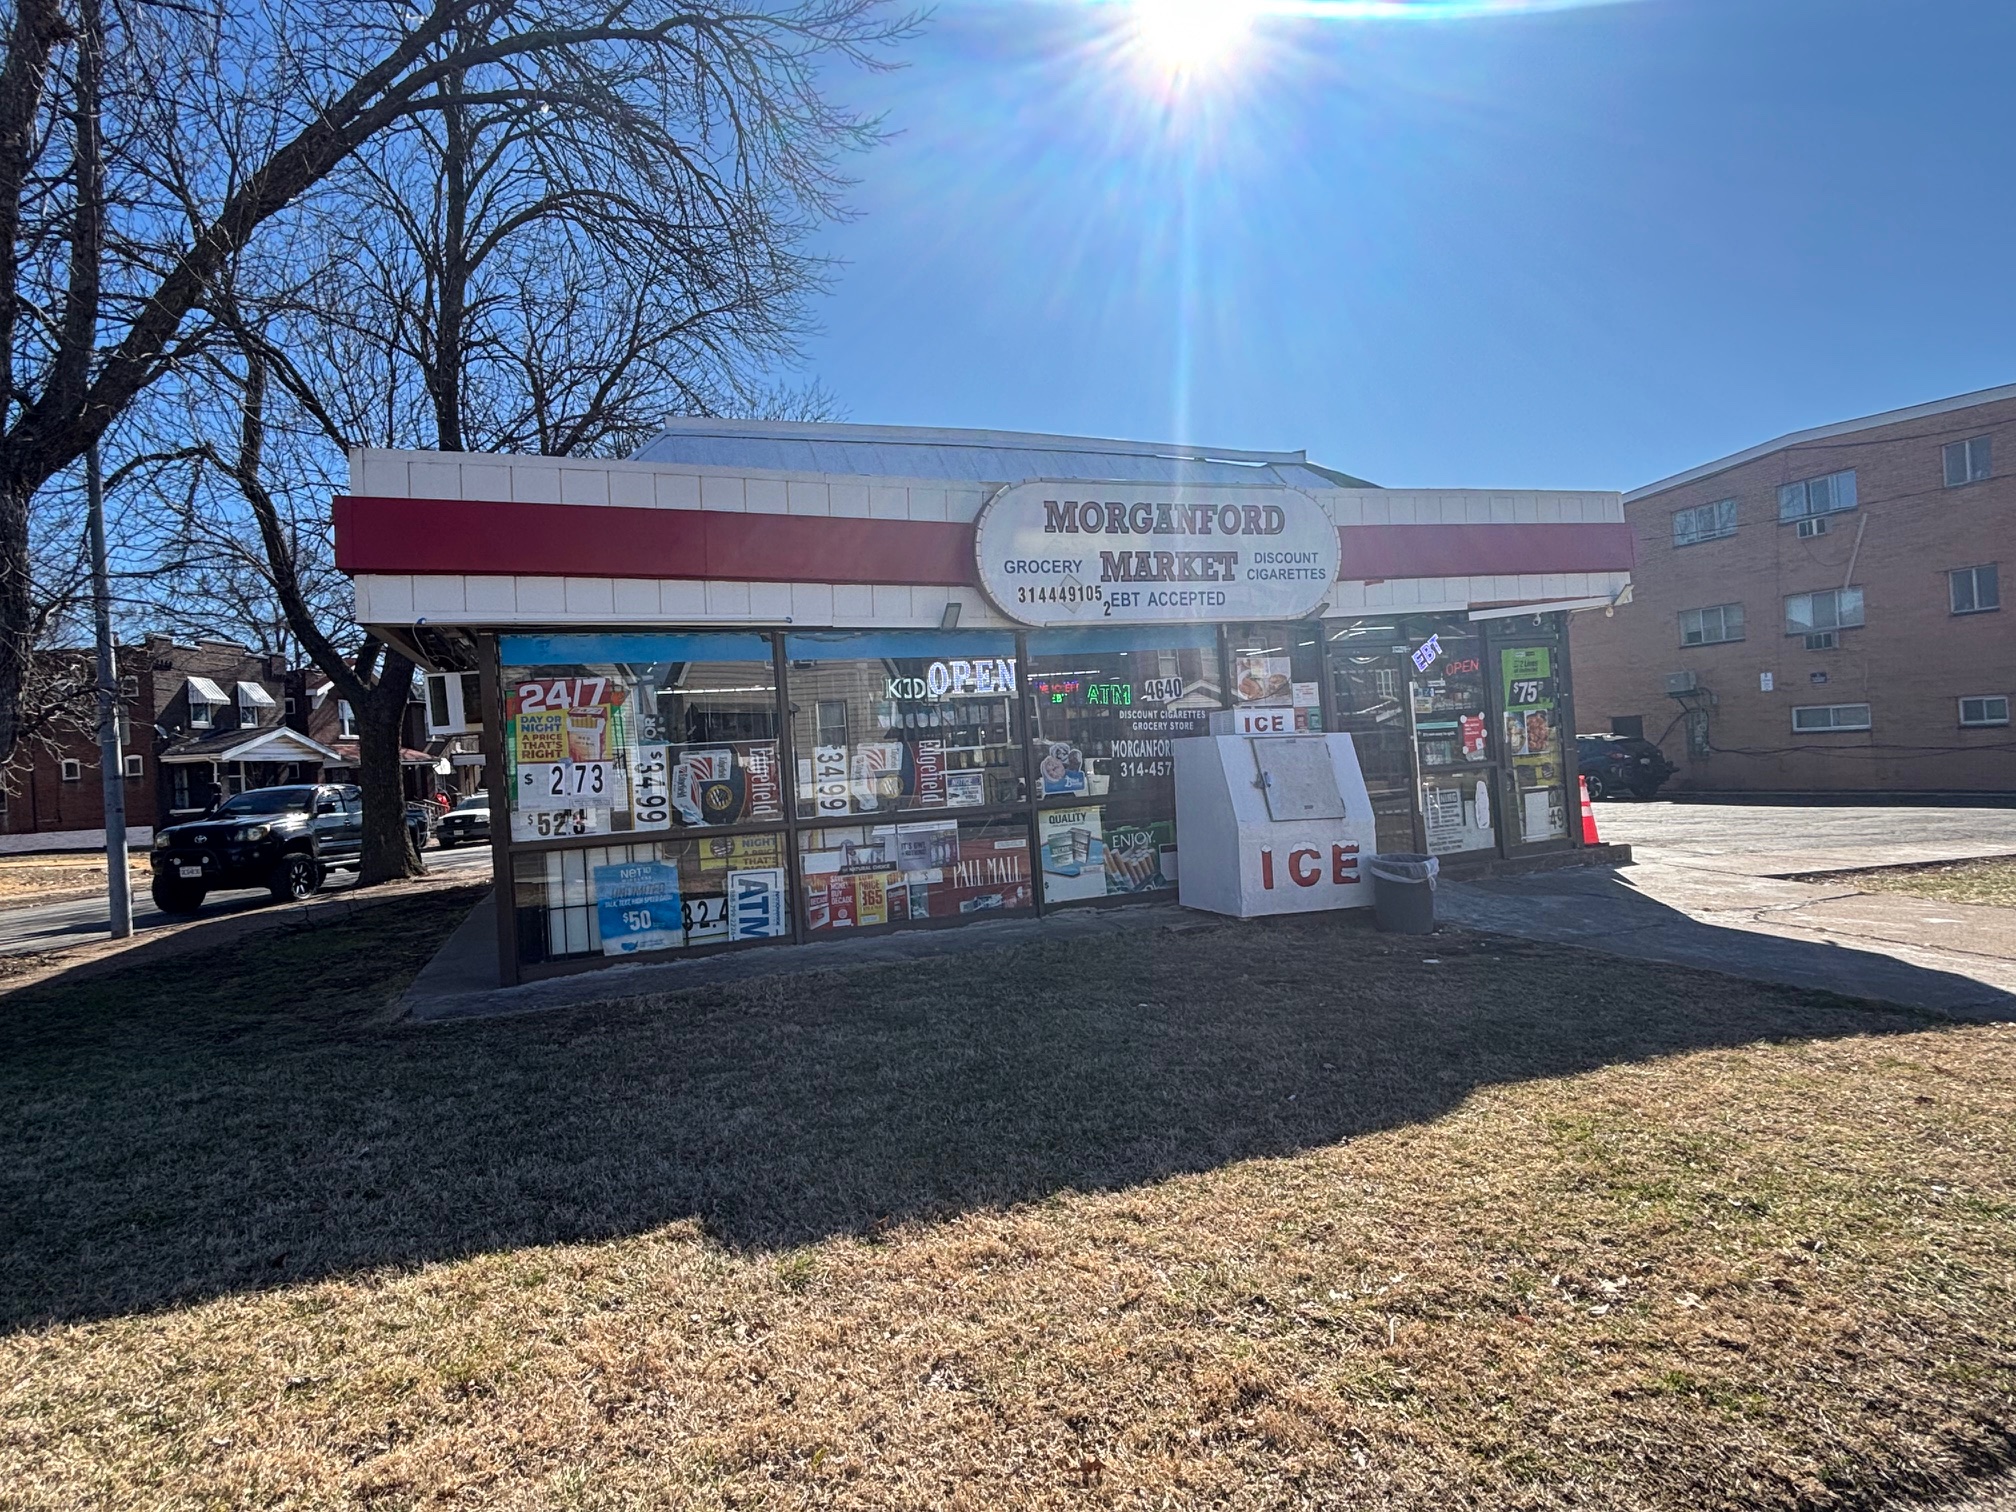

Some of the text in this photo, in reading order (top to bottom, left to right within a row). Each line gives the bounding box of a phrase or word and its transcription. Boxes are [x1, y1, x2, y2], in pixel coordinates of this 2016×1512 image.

[1043, 500, 1286, 536] MORGANFORD
[1004, 558, 1083, 575] GROCERY
[1100, 551, 1239, 582] MARKET
[1254, 551, 1319, 564] DISCOUNT
[1247, 567, 1326, 580] CIGARETTES
[1110, 591, 1226, 607] EBT ACCEPTED
[1103, 601, 1112, 617] 2
[1411, 633, 1443, 673] EBT
[1445, 658, 1480, 676] OPEN
[928, 659, 1017, 695] OPEN
[519, 677, 607, 714] 24/7
[1087, 684, 1132, 706] ATM
[1147, 678, 1183, 700] 4640
[1513, 681, 1538, 703] $75
[520, 715, 562, 724] DAY OR
[1119, 710, 1206, 719] DISCOUNT CIGARETTES
[1244, 715, 1284, 733] ICE
[520, 723, 562, 732] NIGHT
[1132, 721, 1194, 731] GROCERY STORE
[521, 750, 563, 759] RIGHT
[522, 741, 563, 750] THAT'S
[1111, 739, 1175, 758] MORGANFOR
[747, 746, 779, 815] Edgefield
[917, 739, 944, 803] Edgefield
[1049, 812, 1087, 824] QUALITY
[953, 856, 1022, 889] PALL MALL
[1261, 840, 1361, 890] ICE
[738, 878, 770, 937] ATM
[622, 910, 652, 931] $50
